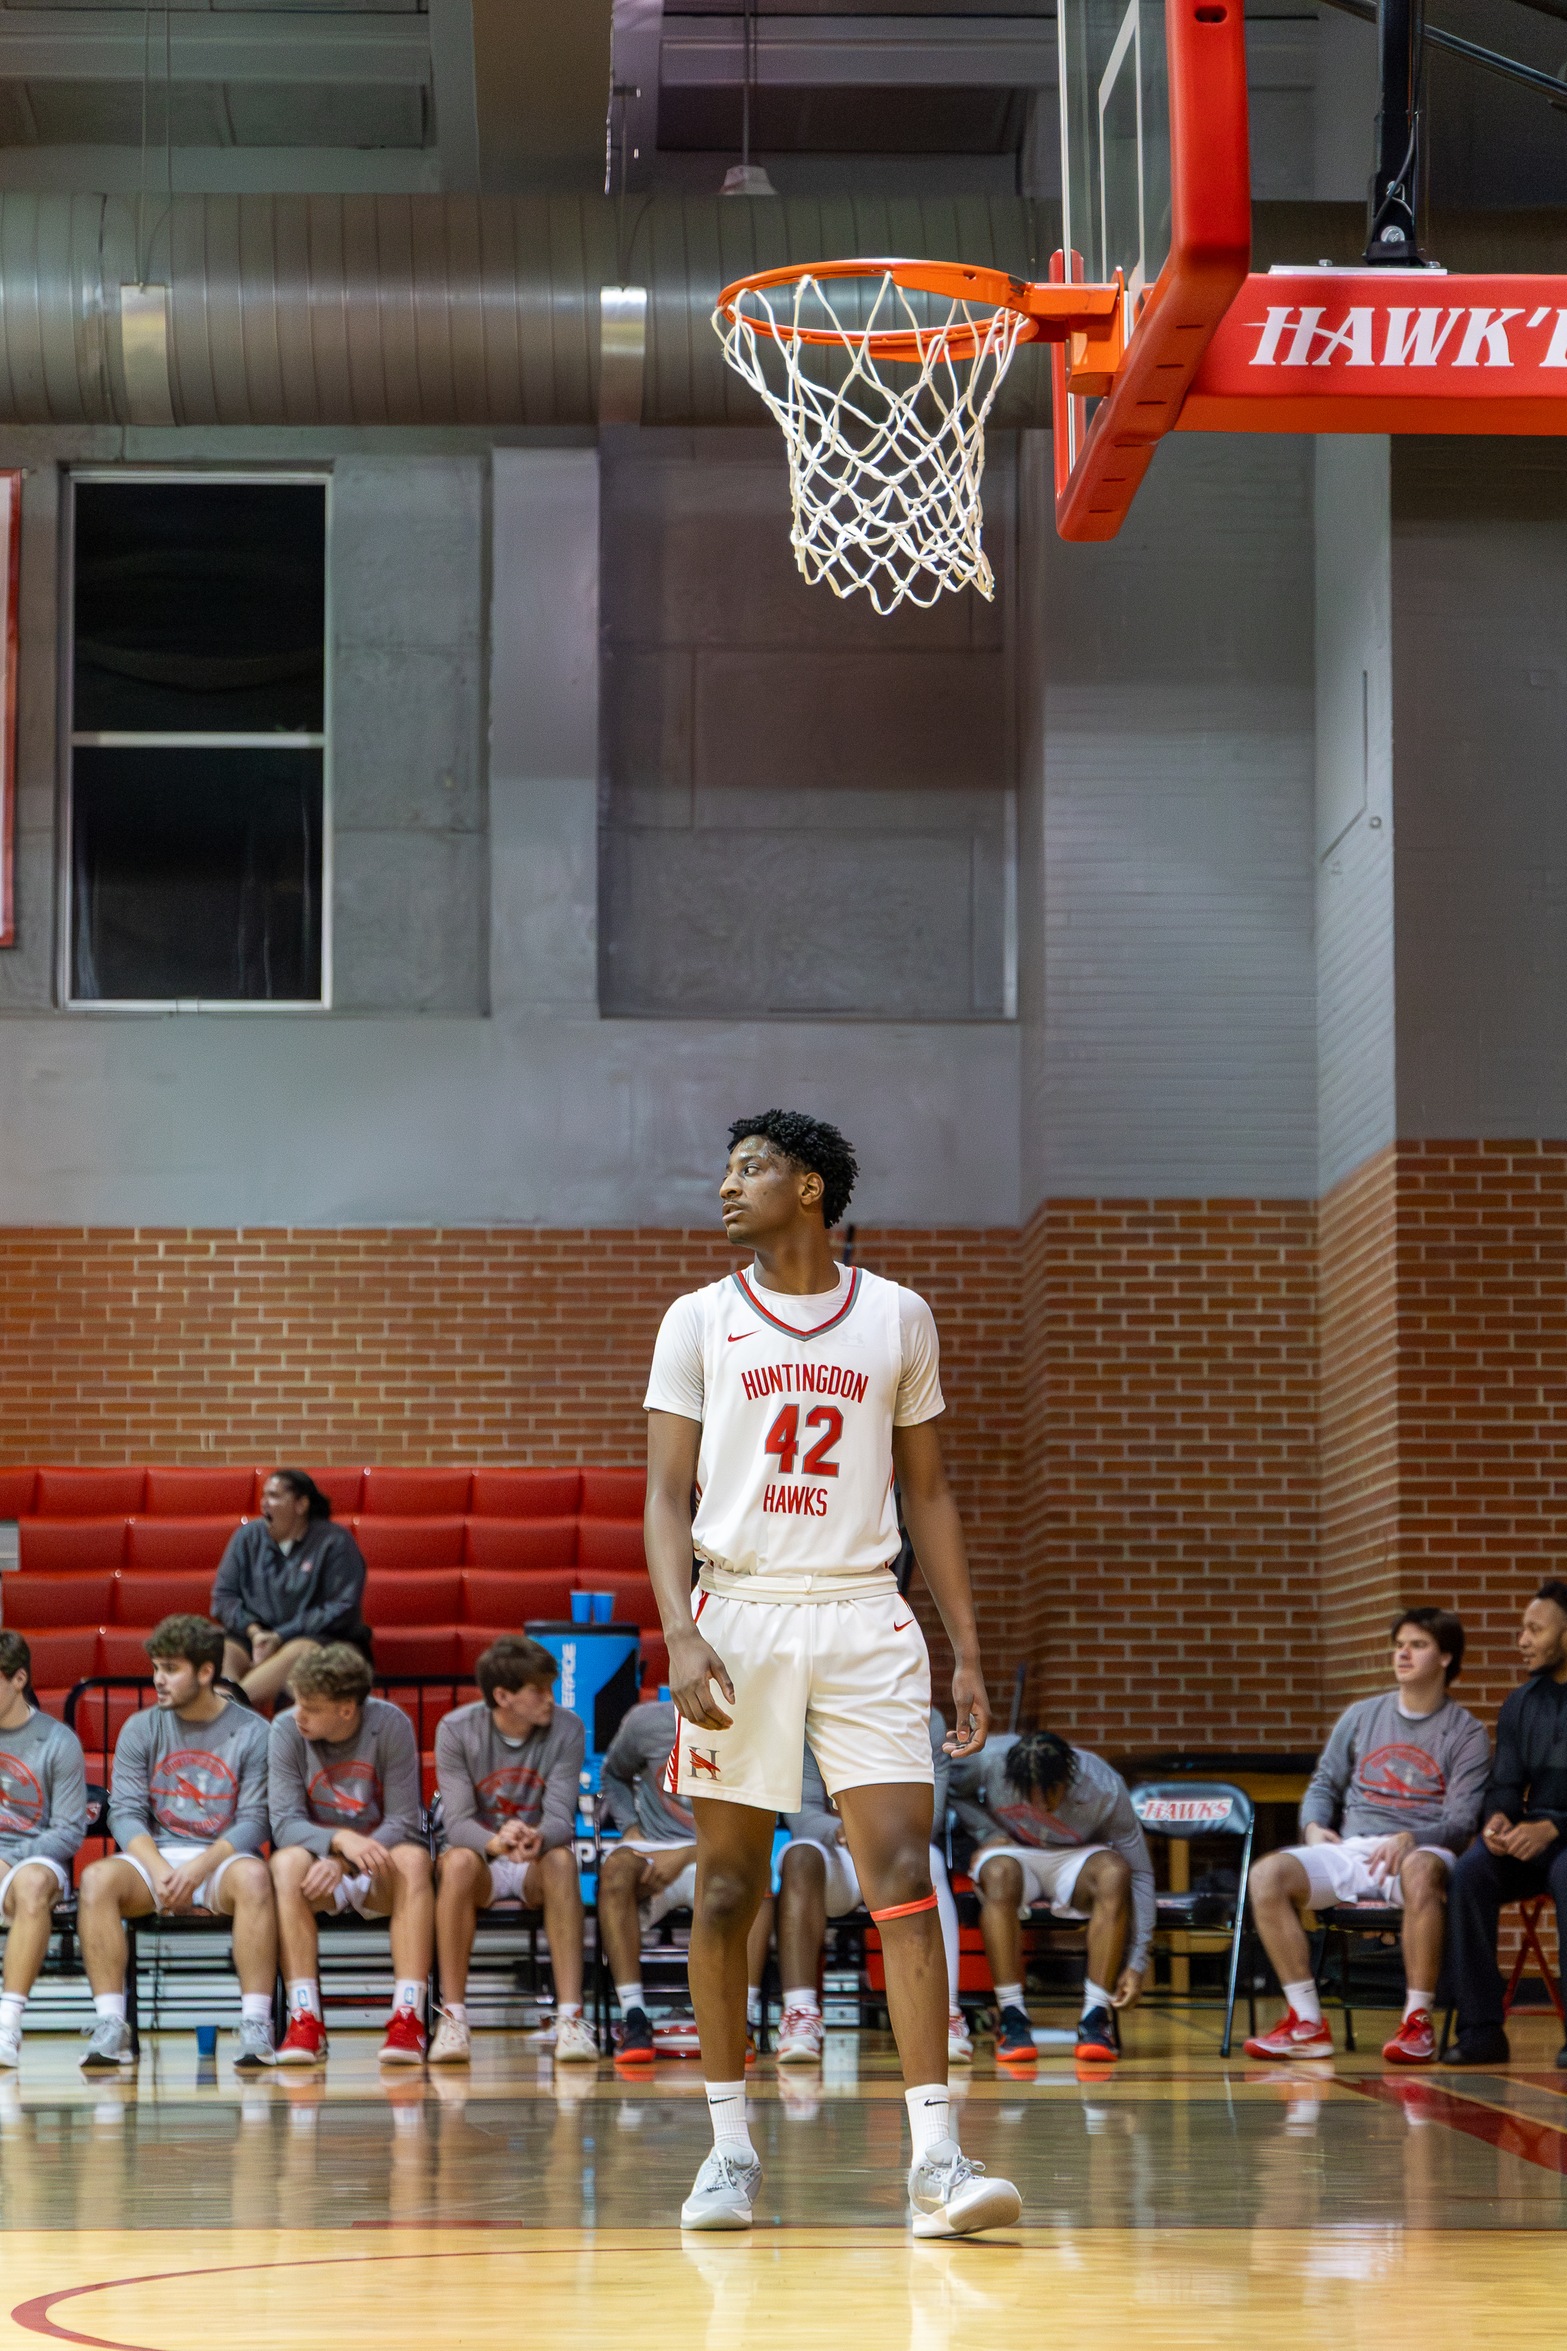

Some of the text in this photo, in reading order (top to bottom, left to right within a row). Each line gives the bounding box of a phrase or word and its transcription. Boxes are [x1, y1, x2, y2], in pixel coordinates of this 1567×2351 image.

[741, 1363, 869, 1403] HUNTINGDON
[764, 1403, 844, 1478] 42
[763, 1484, 828, 1517] HAWKS
[561, 1643, 577, 1708] ERADE
[1141, 1799, 1232, 1820] HAWKS
